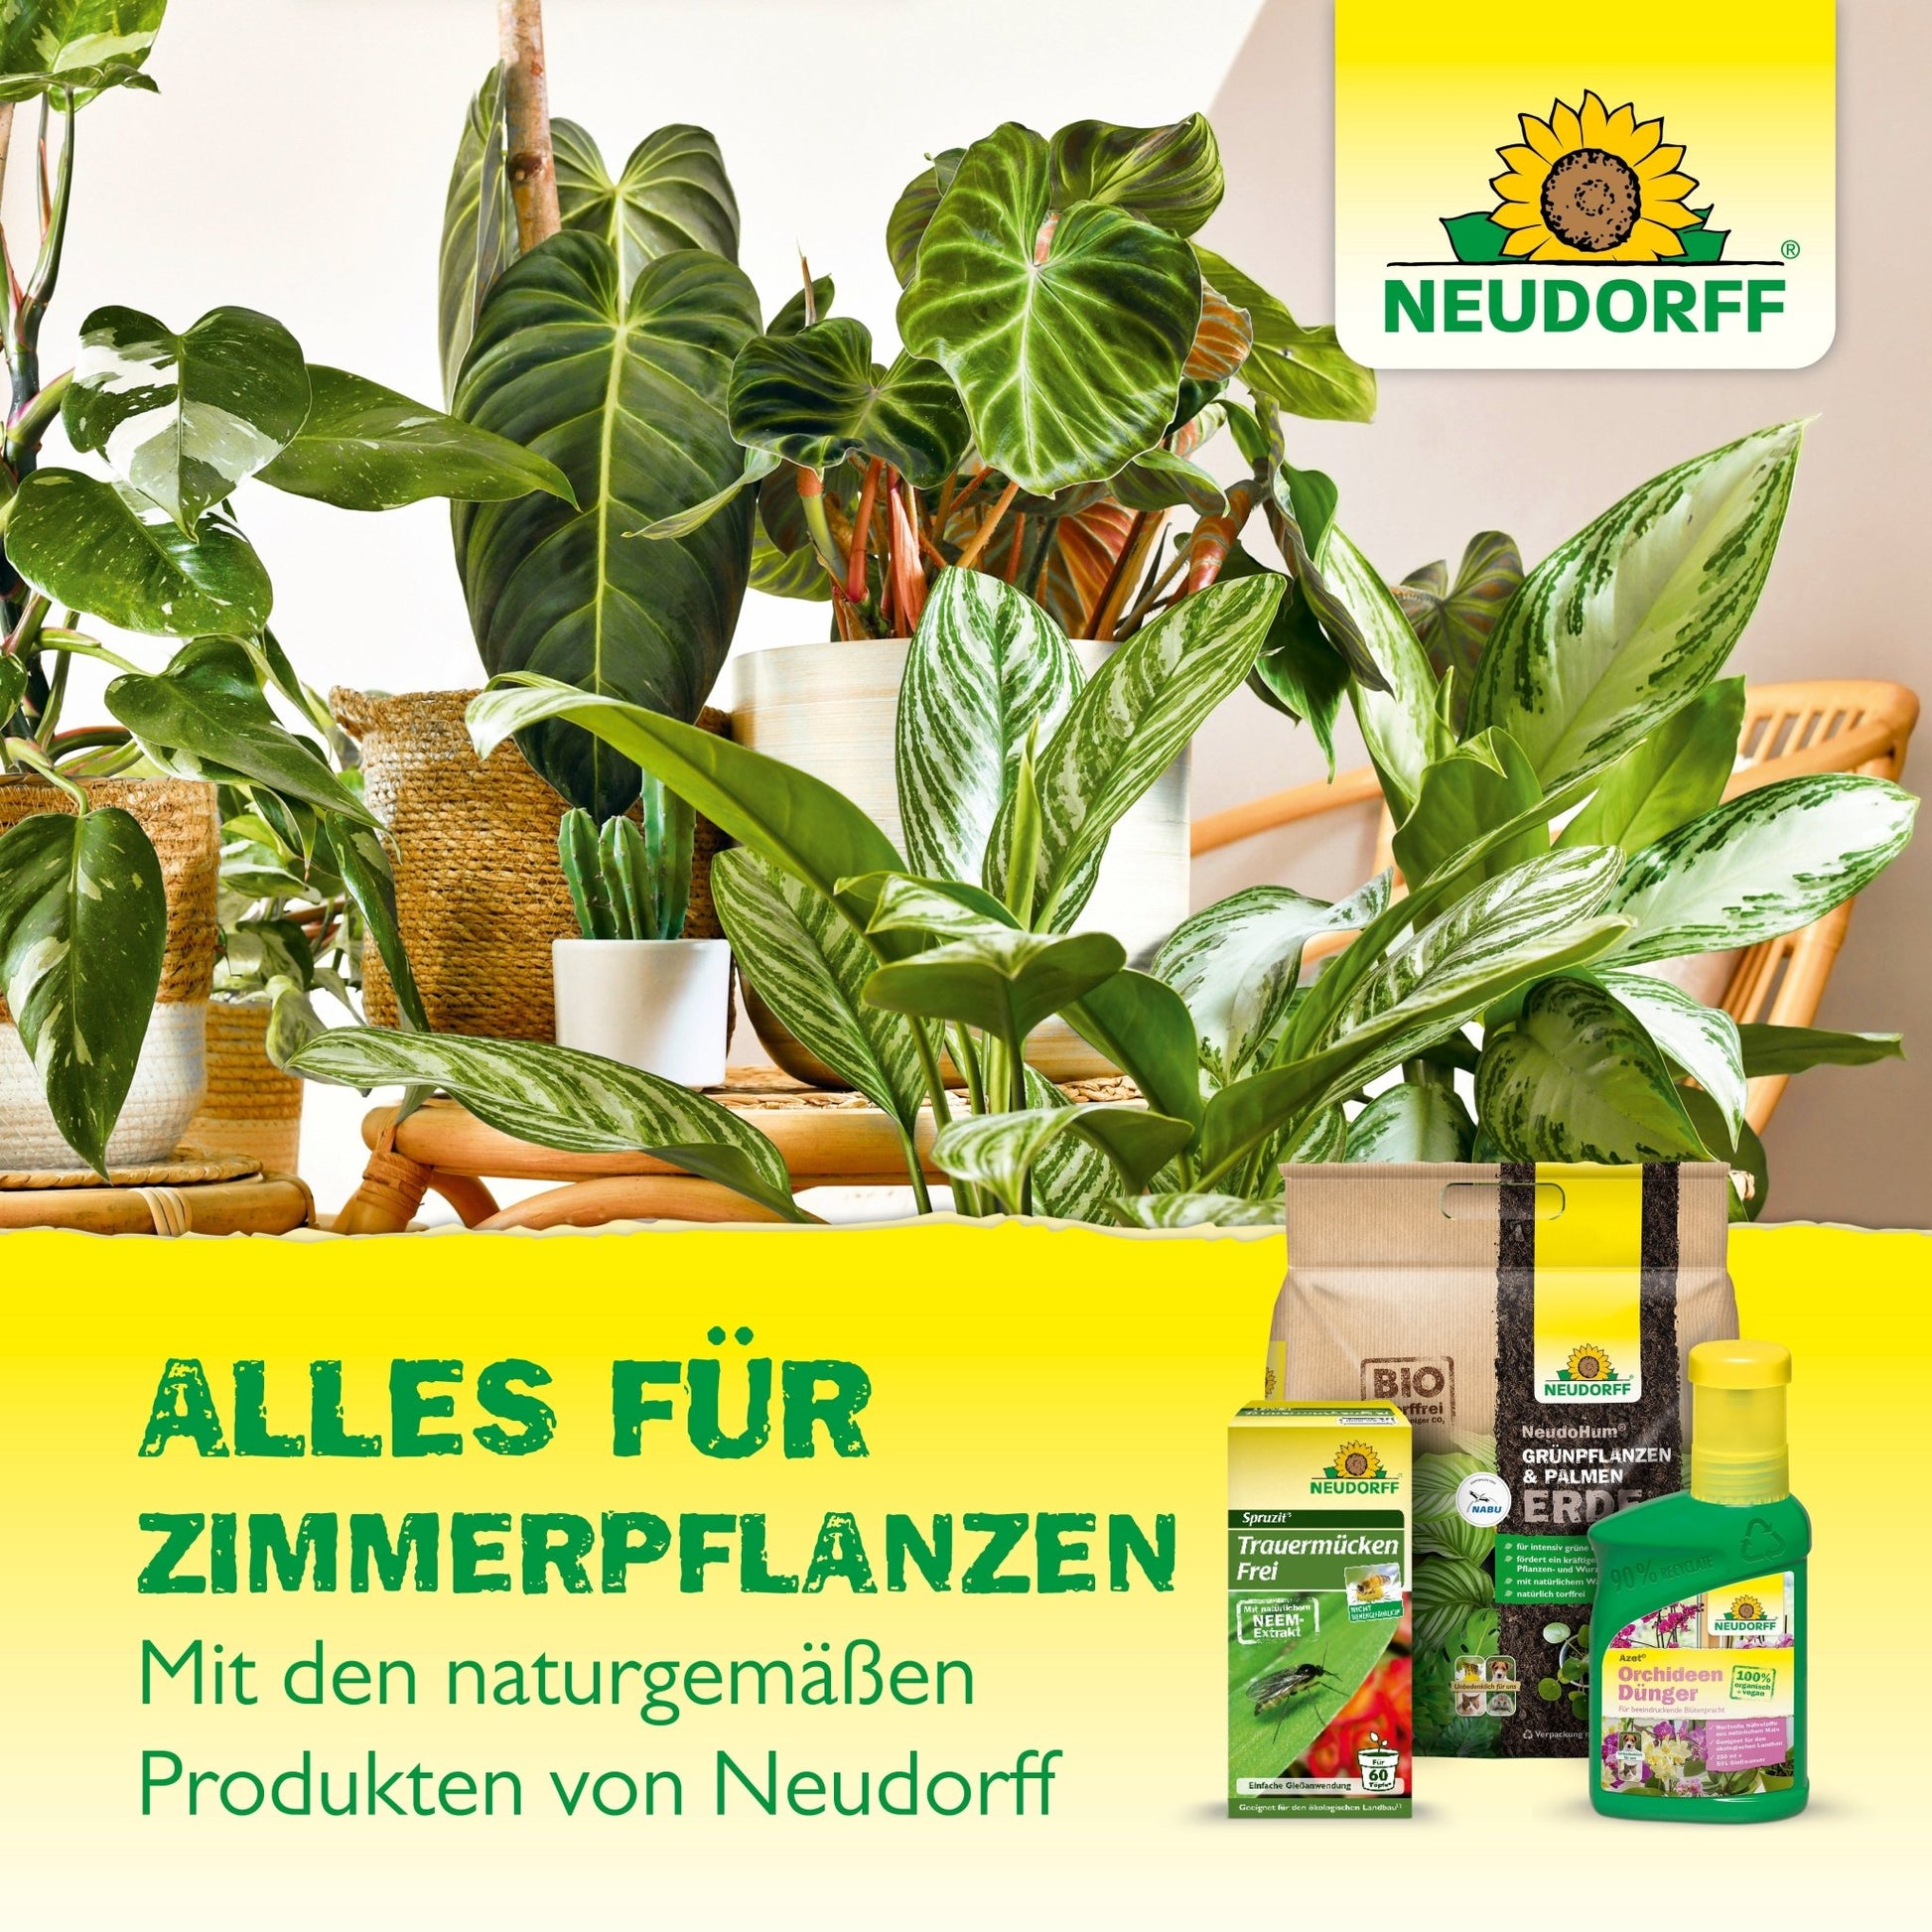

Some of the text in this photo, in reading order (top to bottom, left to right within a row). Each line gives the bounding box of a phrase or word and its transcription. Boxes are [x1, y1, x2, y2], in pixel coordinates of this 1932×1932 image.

[1374, 1366, 1446, 1399] BIO
[1544, 1383, 1631, 1396] NEUDORFF
[1398, 1401, 1444, 1416] rffrei
[1522, 1444, 1673, 1464] GRÜNPFLANZEN
[1522, 1468, 1624, 1484] & PALMEN
[1310, 1481, 1400, 1494] NEUDORFF
[1471, 1505, 1502, 1514] NABU
[1237, 1534, 1399, 1556] Trauermücken
[1530, 1543, 1564, 1552] intensiv
[1564, 1545, 1589, 1554] grüne
[1516, 1555, 1547, 1564] fördert
[1236, 1560, 1280, 1582] Frei
[1516, 1589, 1555, 1598] natürlich
[1252, 1613, 1305, 1628] NEEM-
[1715, 1621, 1777, 1631] NEUDORFF
[1253, 1626, 1302, 1639] Extrakt
[1617, 1665, 1724, 1683] Orchideen
[1735, 1669, 1772, 1684] 100%
[1733, 1682, 1771, 1692] organisch
[1742, 1689, 1765, 1698] vegan
[1617, 1684, 1699, 1706] Dünger
[1631, 1706, 1683, 1715] beeindruckende
[1535, 1730, 1584, 1740] Verpackung
[1368, 1770, 1389, 1782] 60
[1248, 1781, 1352, 1791] Einfache Gießanwendung
[1238, 1804, 1276, 1814] Geeignet
[1308, 1804, 1361, 1814] ökologischen
